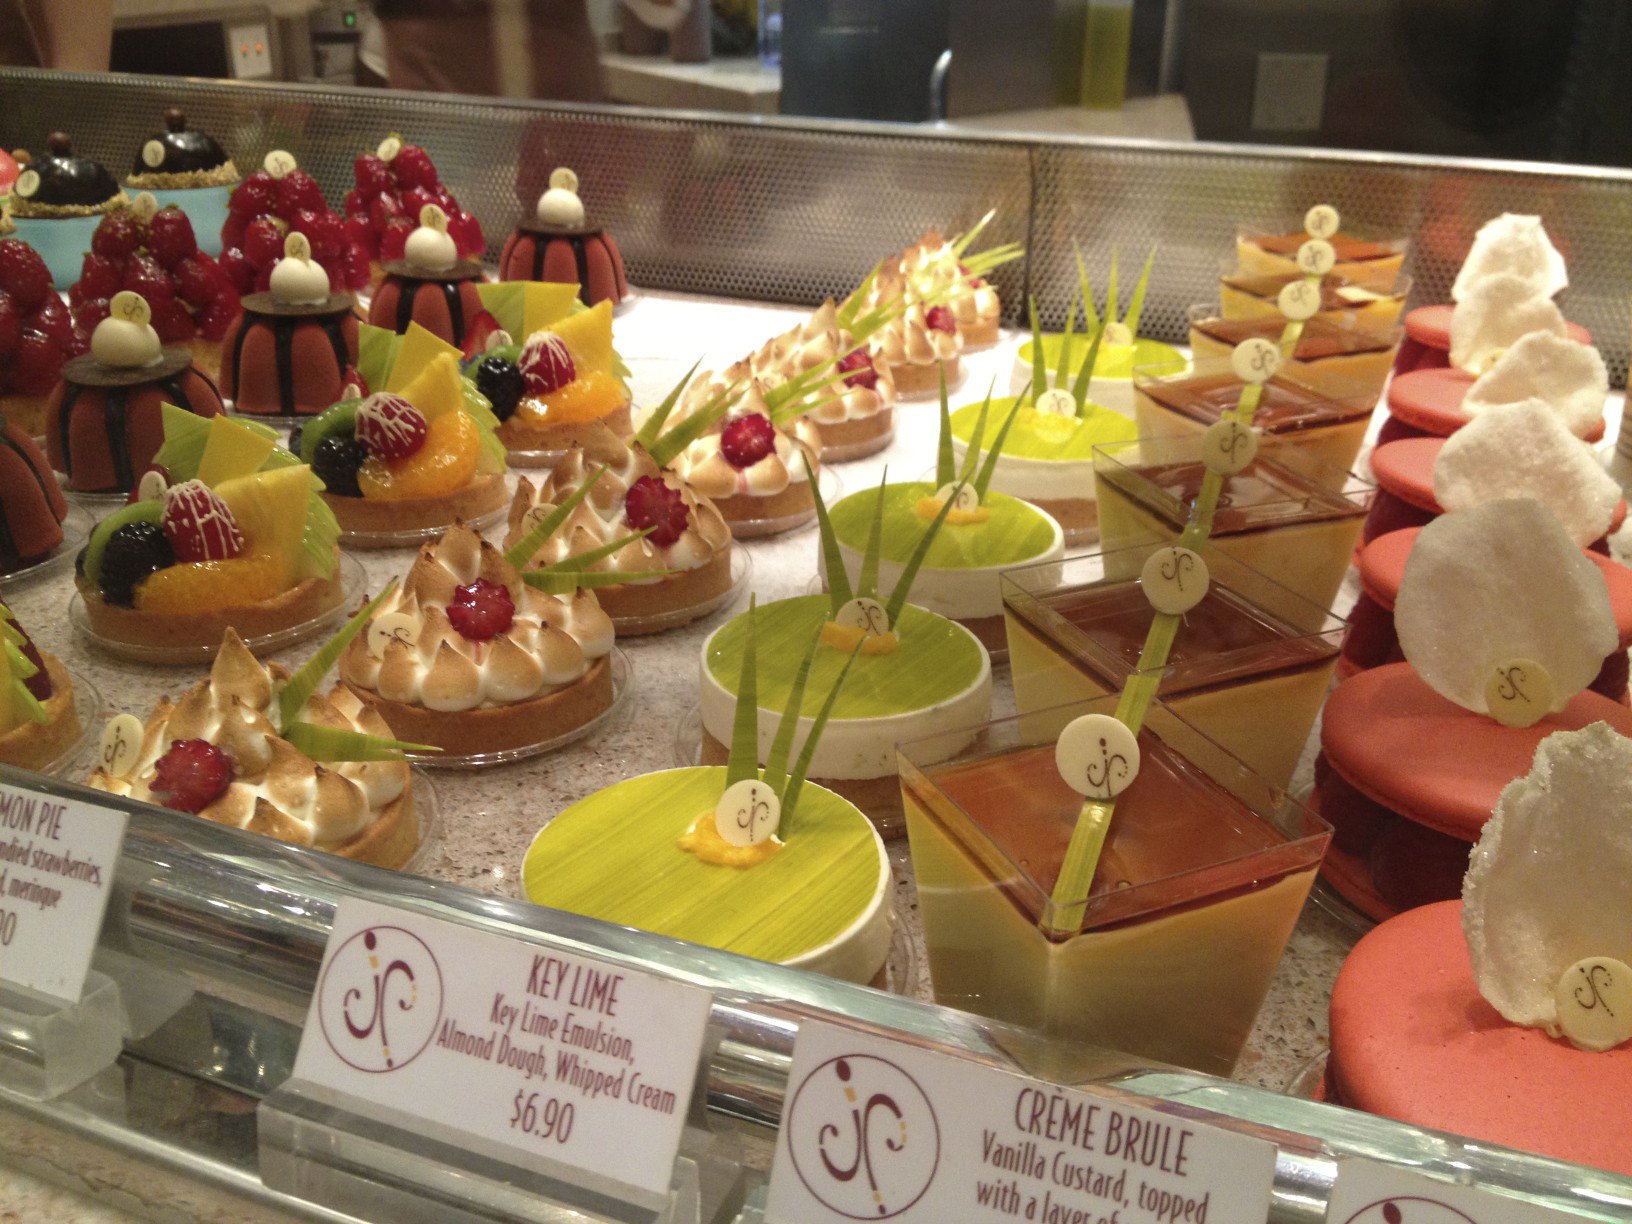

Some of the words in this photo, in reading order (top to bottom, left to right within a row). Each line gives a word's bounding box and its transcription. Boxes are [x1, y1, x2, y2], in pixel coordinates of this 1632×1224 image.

[36, 801, 67, 840] PIE
[527, 954, 570, 1000] KEY
[569, 965, 624, 1017] LIME
[490, 992, 519, 1033] Key
[521, 1002, 559, 1040] Lime
[560, 1013, 635, 1065] Emulsion,
[437, 1018, 496, 1061] Almond
[498, 1035, 548, 1081] Dough,
[555, 1049, 626, 1099] Whipped
[628, 1071, 677, 1115] Cream
[510, 1088, 574, 1144] $6.90
[1014, 1085, 1101, 1152] CRÈME
[1106, 1110, 1194, 1177] BRULE
[976, 1179, 1022, 1215] with
[1025, 1195, 1037, 1219] a
[1041, 1190, 1091, 1224] layer
[981, 1128, 1046, 1180] Vanilla
[1052, 1150, 1129, 1208] Custard,
[1138, 1181, 1211, 1224] topped
